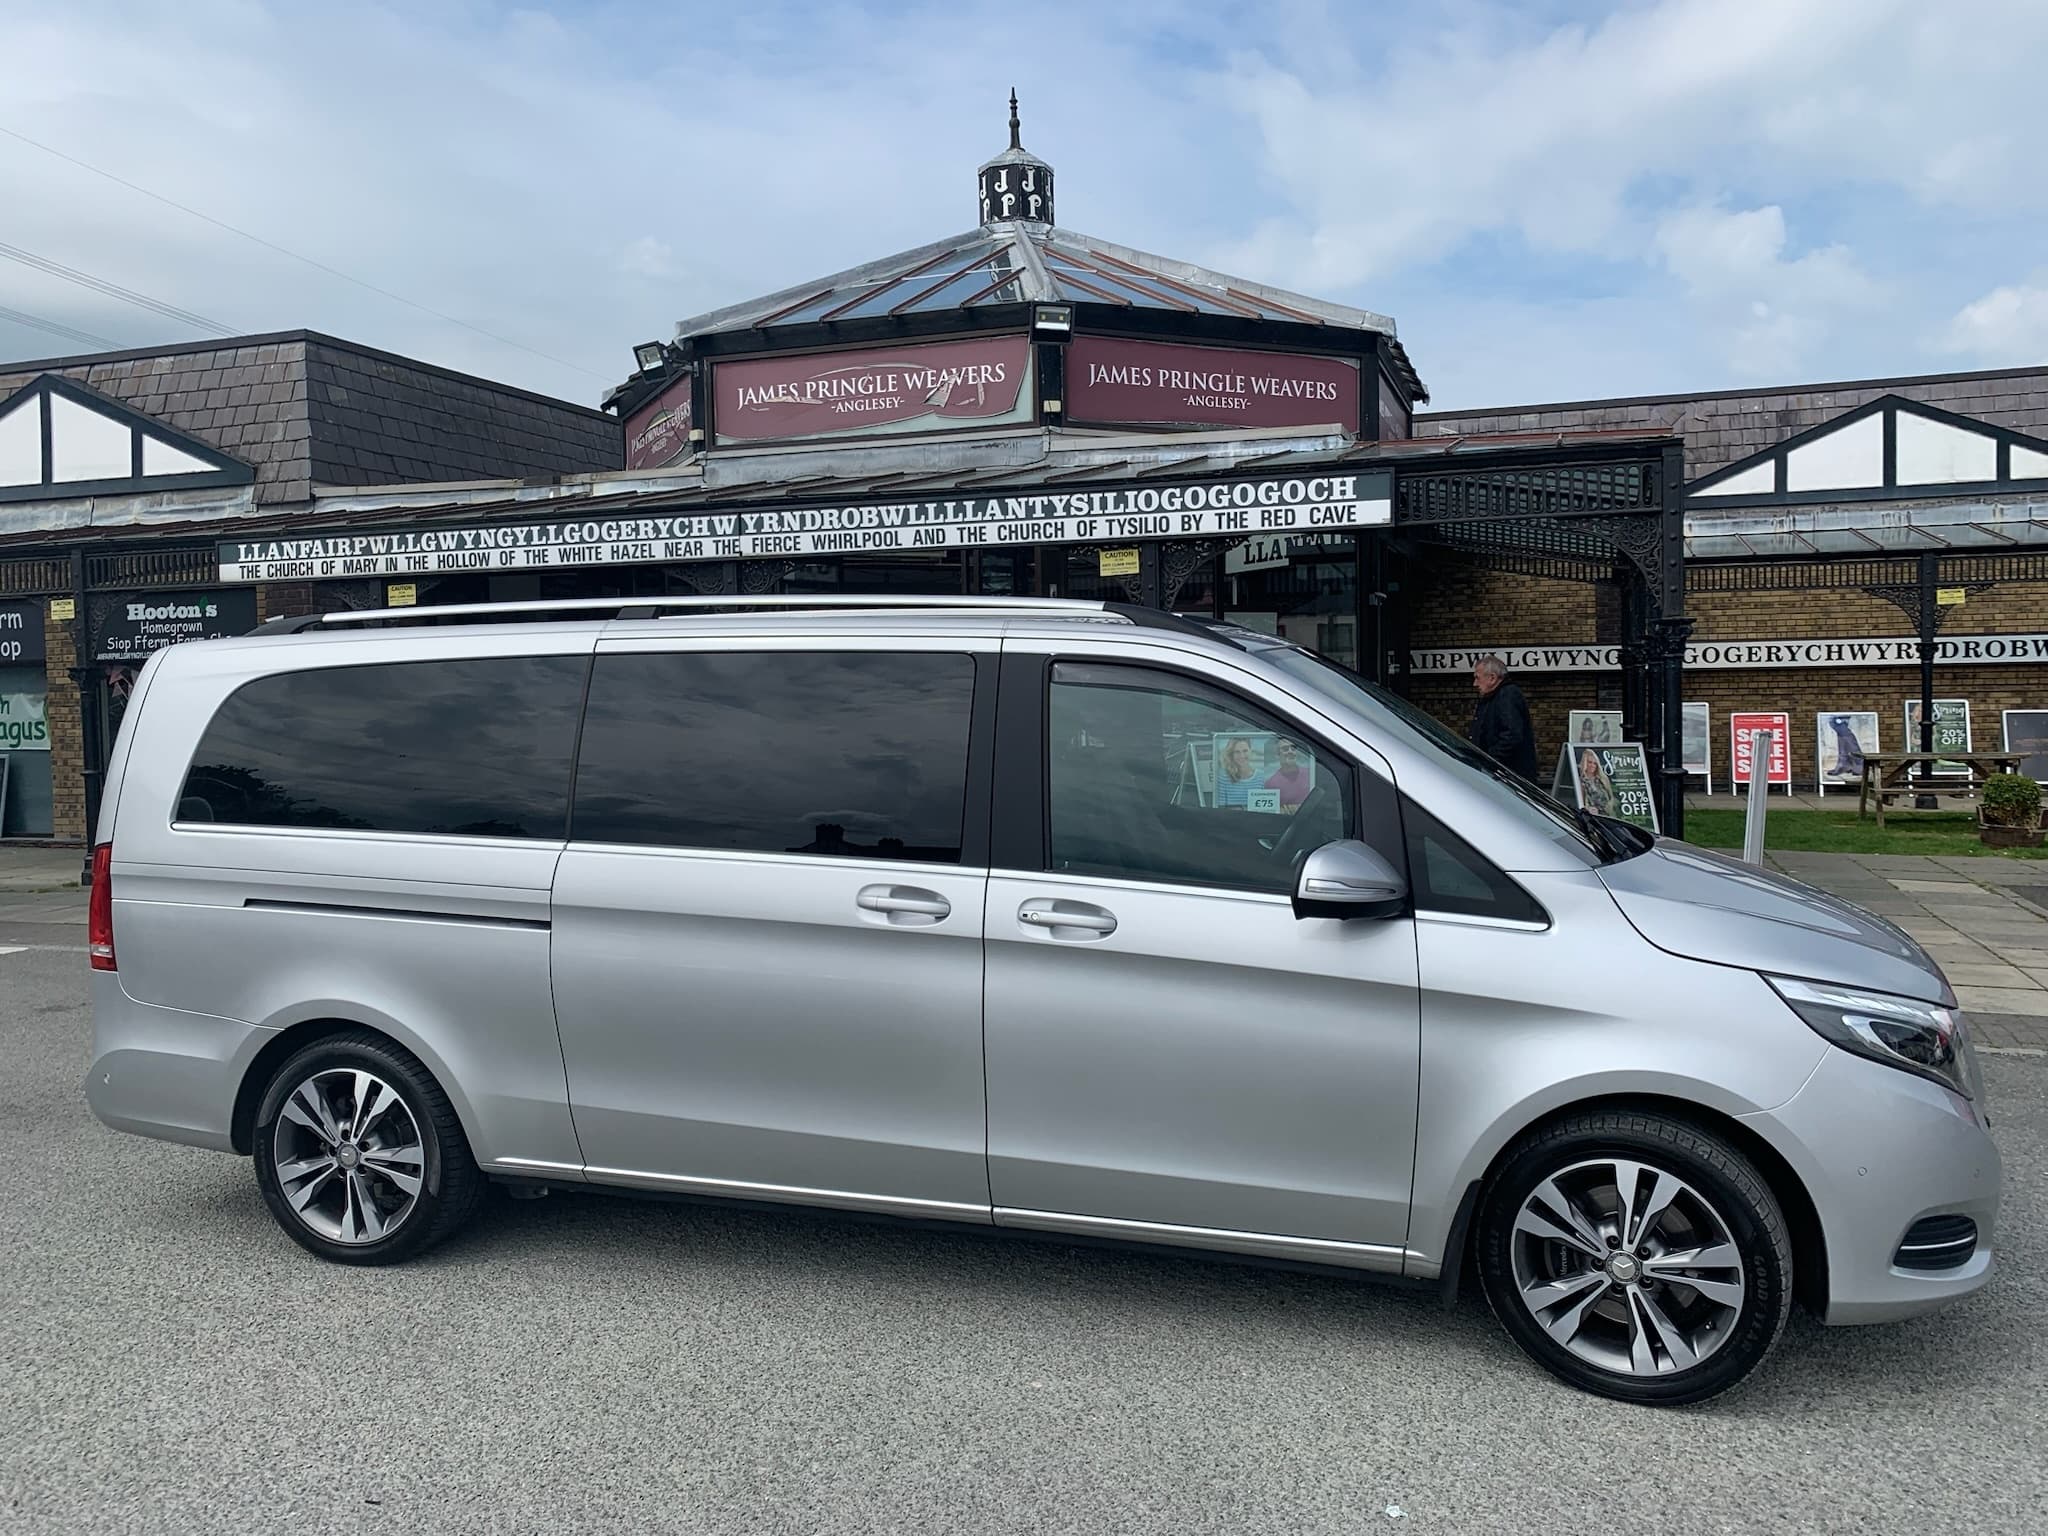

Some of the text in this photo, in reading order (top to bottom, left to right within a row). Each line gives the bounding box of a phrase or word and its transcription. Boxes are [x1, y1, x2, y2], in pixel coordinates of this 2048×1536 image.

[994, 169, 1008, 192] J
[1022, 168, 1035, 192] J
[1001, 193, 1015, 217] P
[1028, 194, 1041, 217] P
[737, 363, 1006, 410] JAMES PRINGLE WEAVERS
[1089, 364, 1337, 401] JAMES PRINGLE WEAVERS
[239, 504, 1357, 579] THE CHURCH OF MARY IN THE HOLLOW OF THE WHITE HAZEL NEAR THE FIERCE WHIRLPOOL AND THE CHURCH OF TYSILIO BY THE RED CAVE
[140, 621, 203, 636] Homegrown
[107, 637, 131, 652] Siop
[135, 635, 170, 649] Fferm
[1736, 728, 1783, 742] SE
[1941, 736, 1963, 745] OFF
[1942, 729, 1966, 737] 20%
[1736, 744, 1784, 757] SE
[1737, 759, 1785, 773] SE
[1619, 791, 1649, 803] 20%
[1621, 803, 1648, 815] OFF
